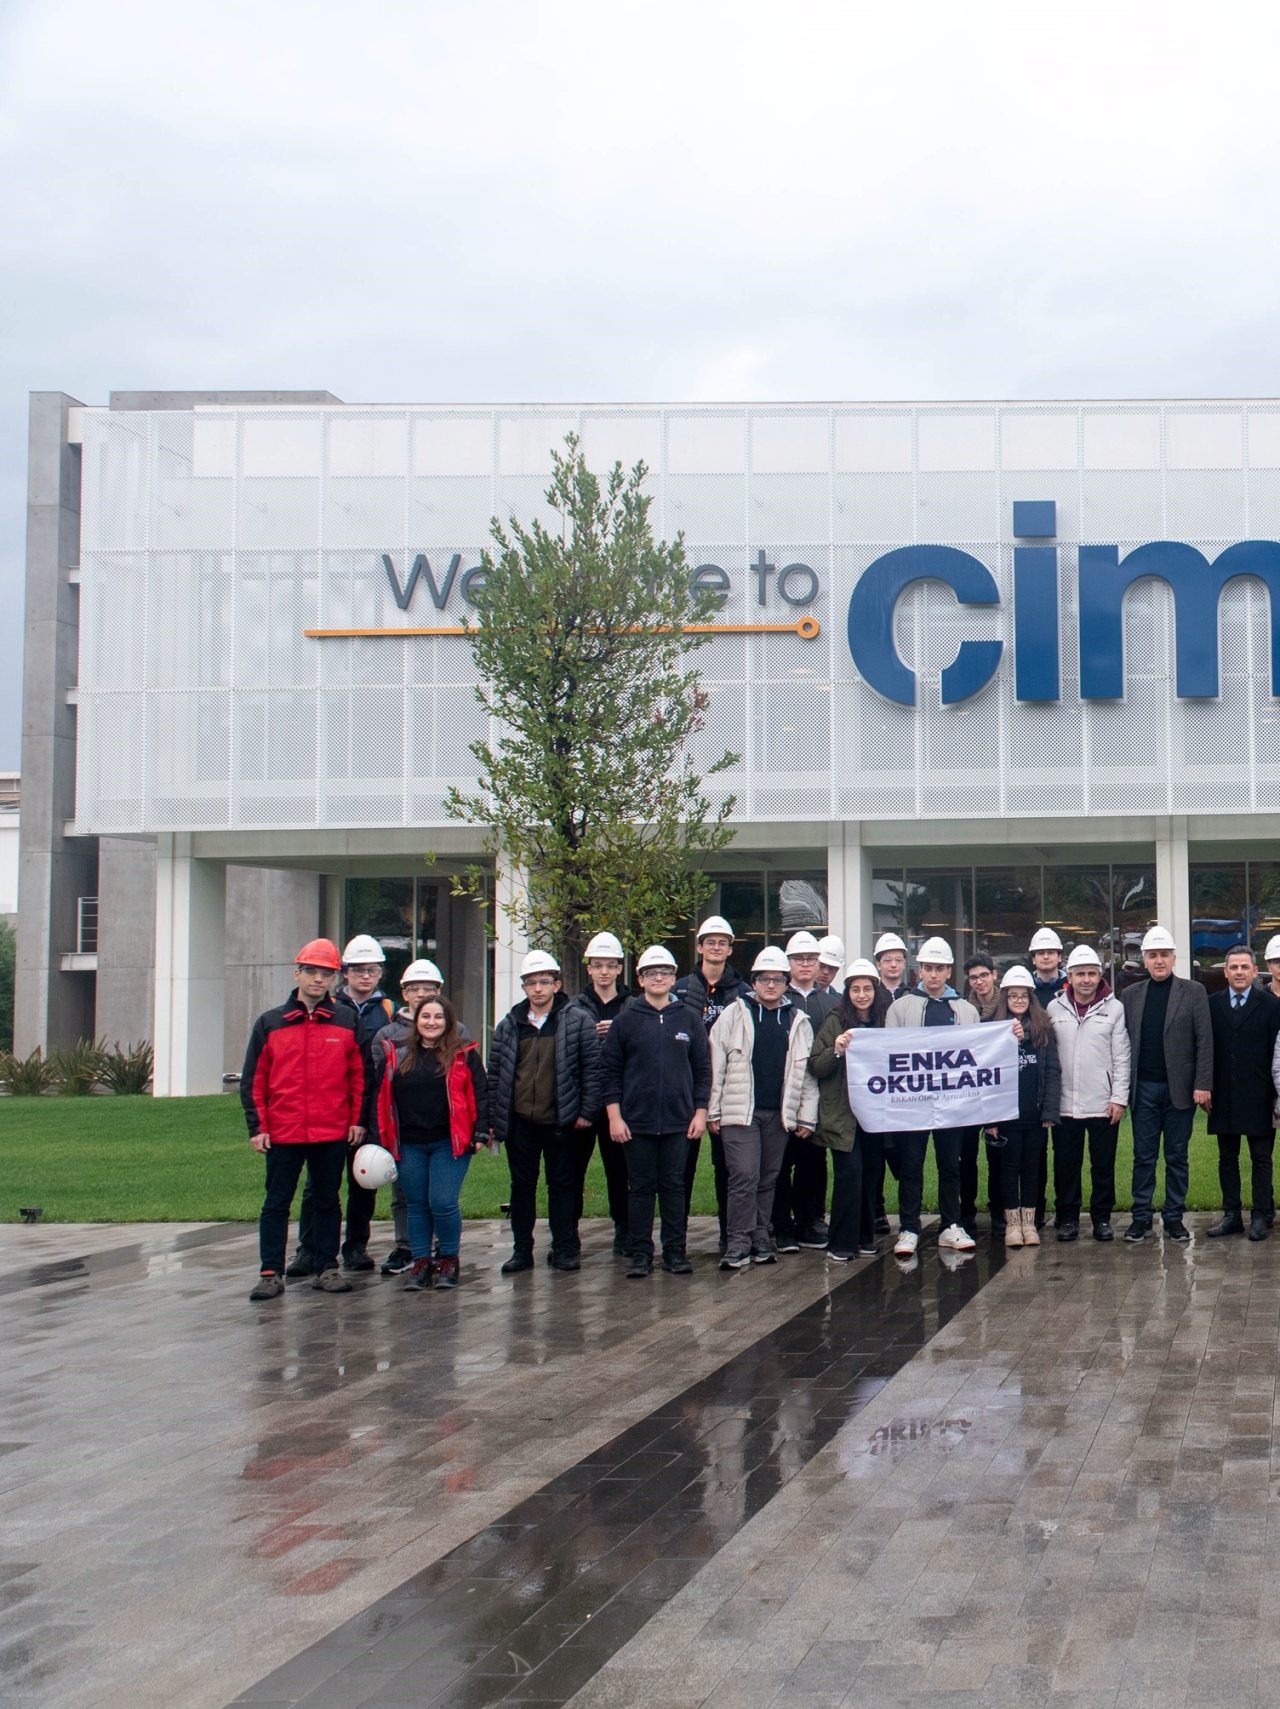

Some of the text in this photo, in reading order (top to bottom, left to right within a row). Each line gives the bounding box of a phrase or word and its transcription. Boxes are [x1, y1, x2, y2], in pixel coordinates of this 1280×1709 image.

[750, 550, 819, 607] to
[888, 1048, 978, 1072] ENKA
[867, 1067, 1001, 1095] OKULLARI
